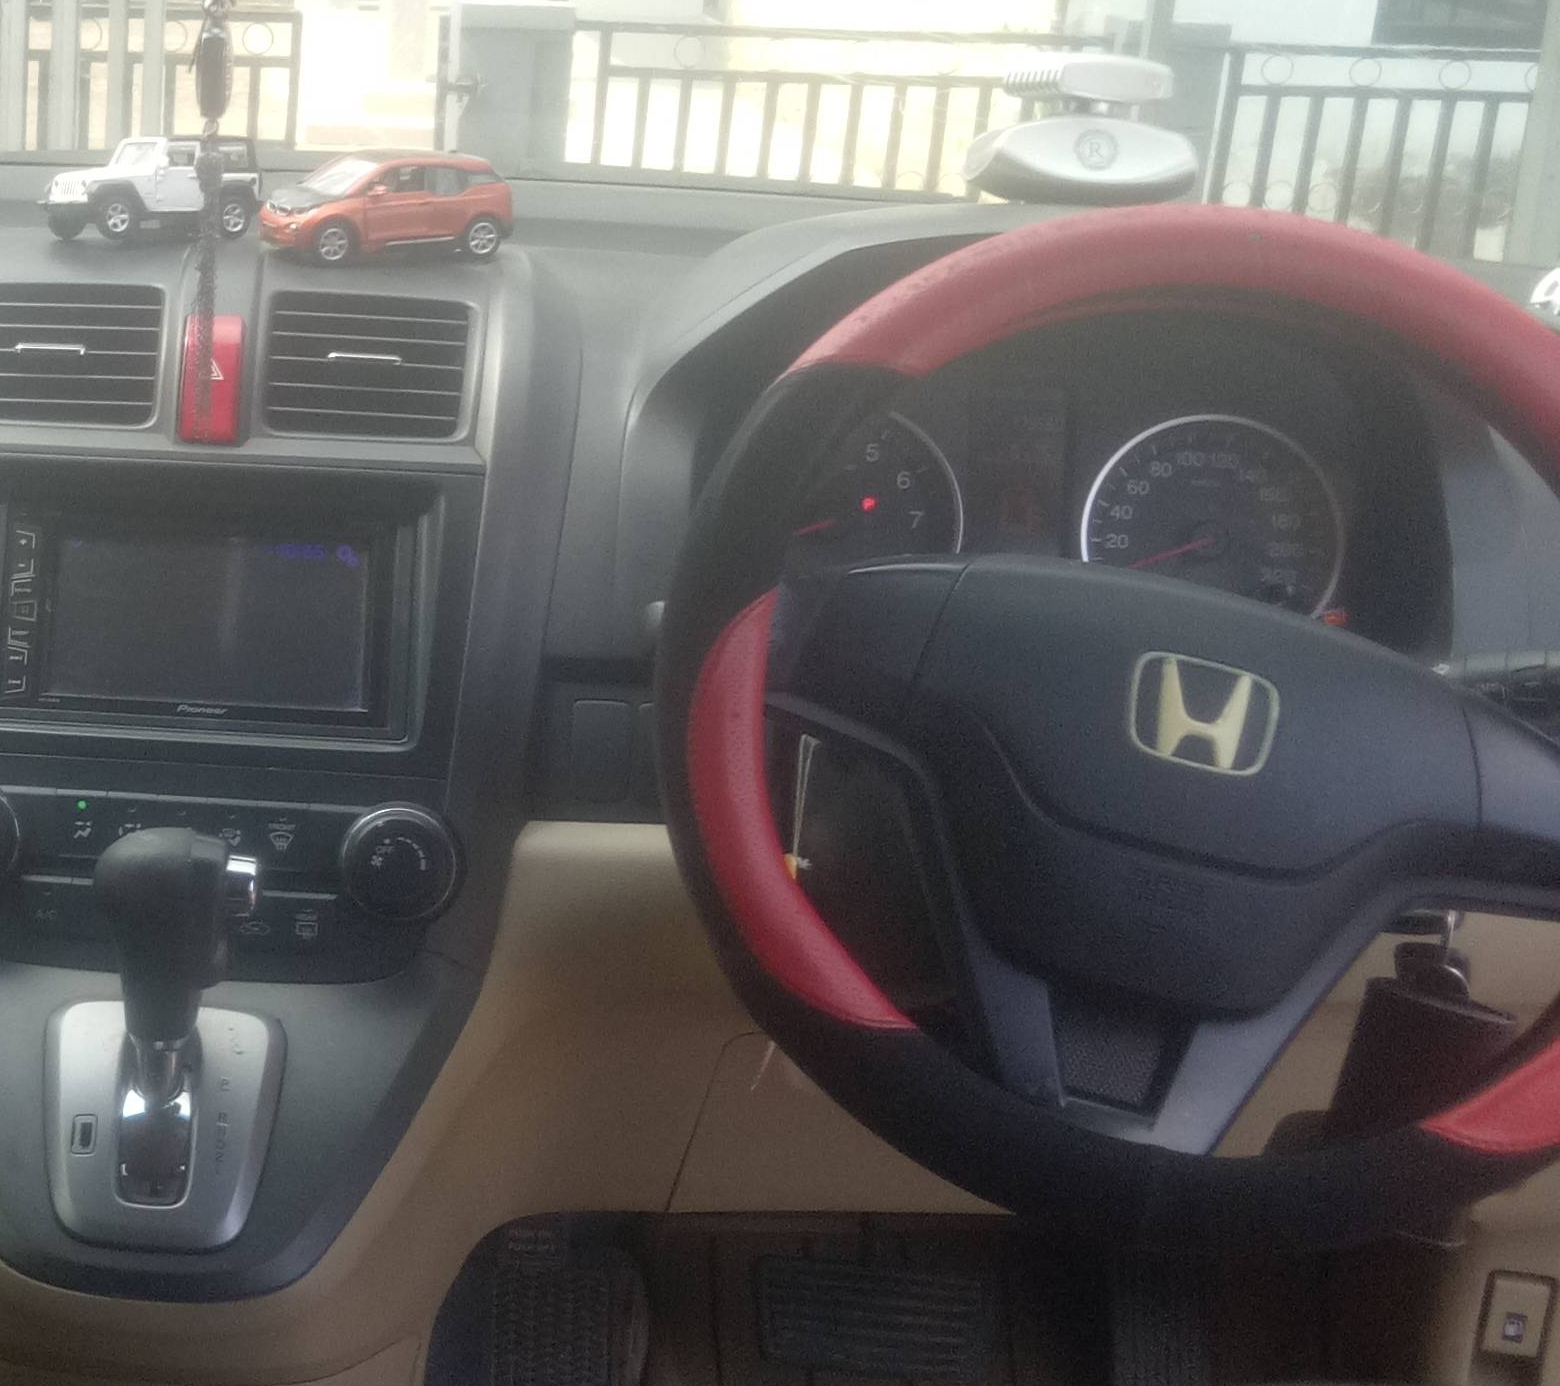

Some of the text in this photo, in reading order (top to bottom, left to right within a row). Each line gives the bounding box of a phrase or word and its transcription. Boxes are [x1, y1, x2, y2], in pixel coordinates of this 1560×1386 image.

[865, 443, 880, 462] 5
[1150, 462, 1172, 477] 80
[896, 471, 911, 489] 6
[1127, 480, 1150, 495] 60
[909, 511, 924, 529] 7
[1110, 505, 1133, 520] 40
[1104, 534, 1129, 549] 20
[176, 704, 229, 714] Pioneer
